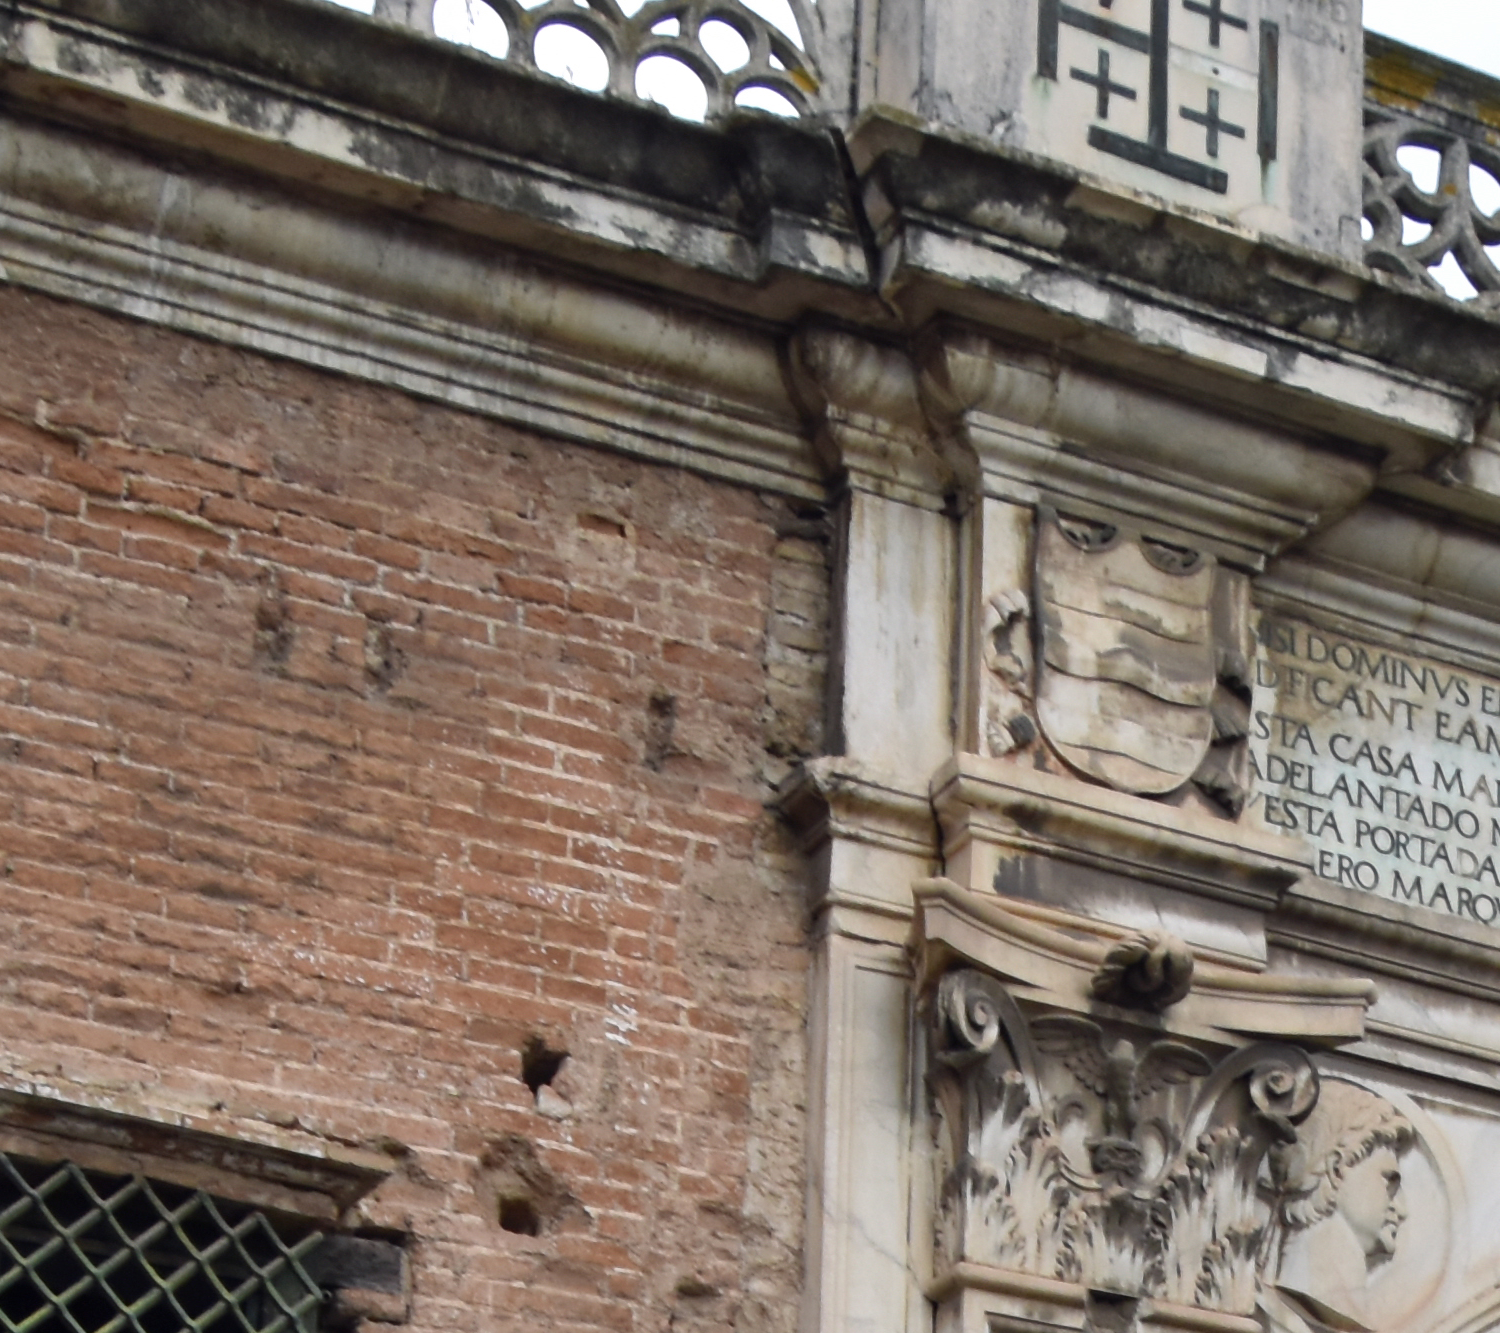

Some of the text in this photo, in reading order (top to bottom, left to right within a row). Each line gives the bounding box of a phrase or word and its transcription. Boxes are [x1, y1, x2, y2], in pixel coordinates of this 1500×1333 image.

[1307, 634, 1471, 708] DOMINVS
[1247, 749, 1480, 839] ADELANTADO
[1328, 733, 1422, 786] CASA
